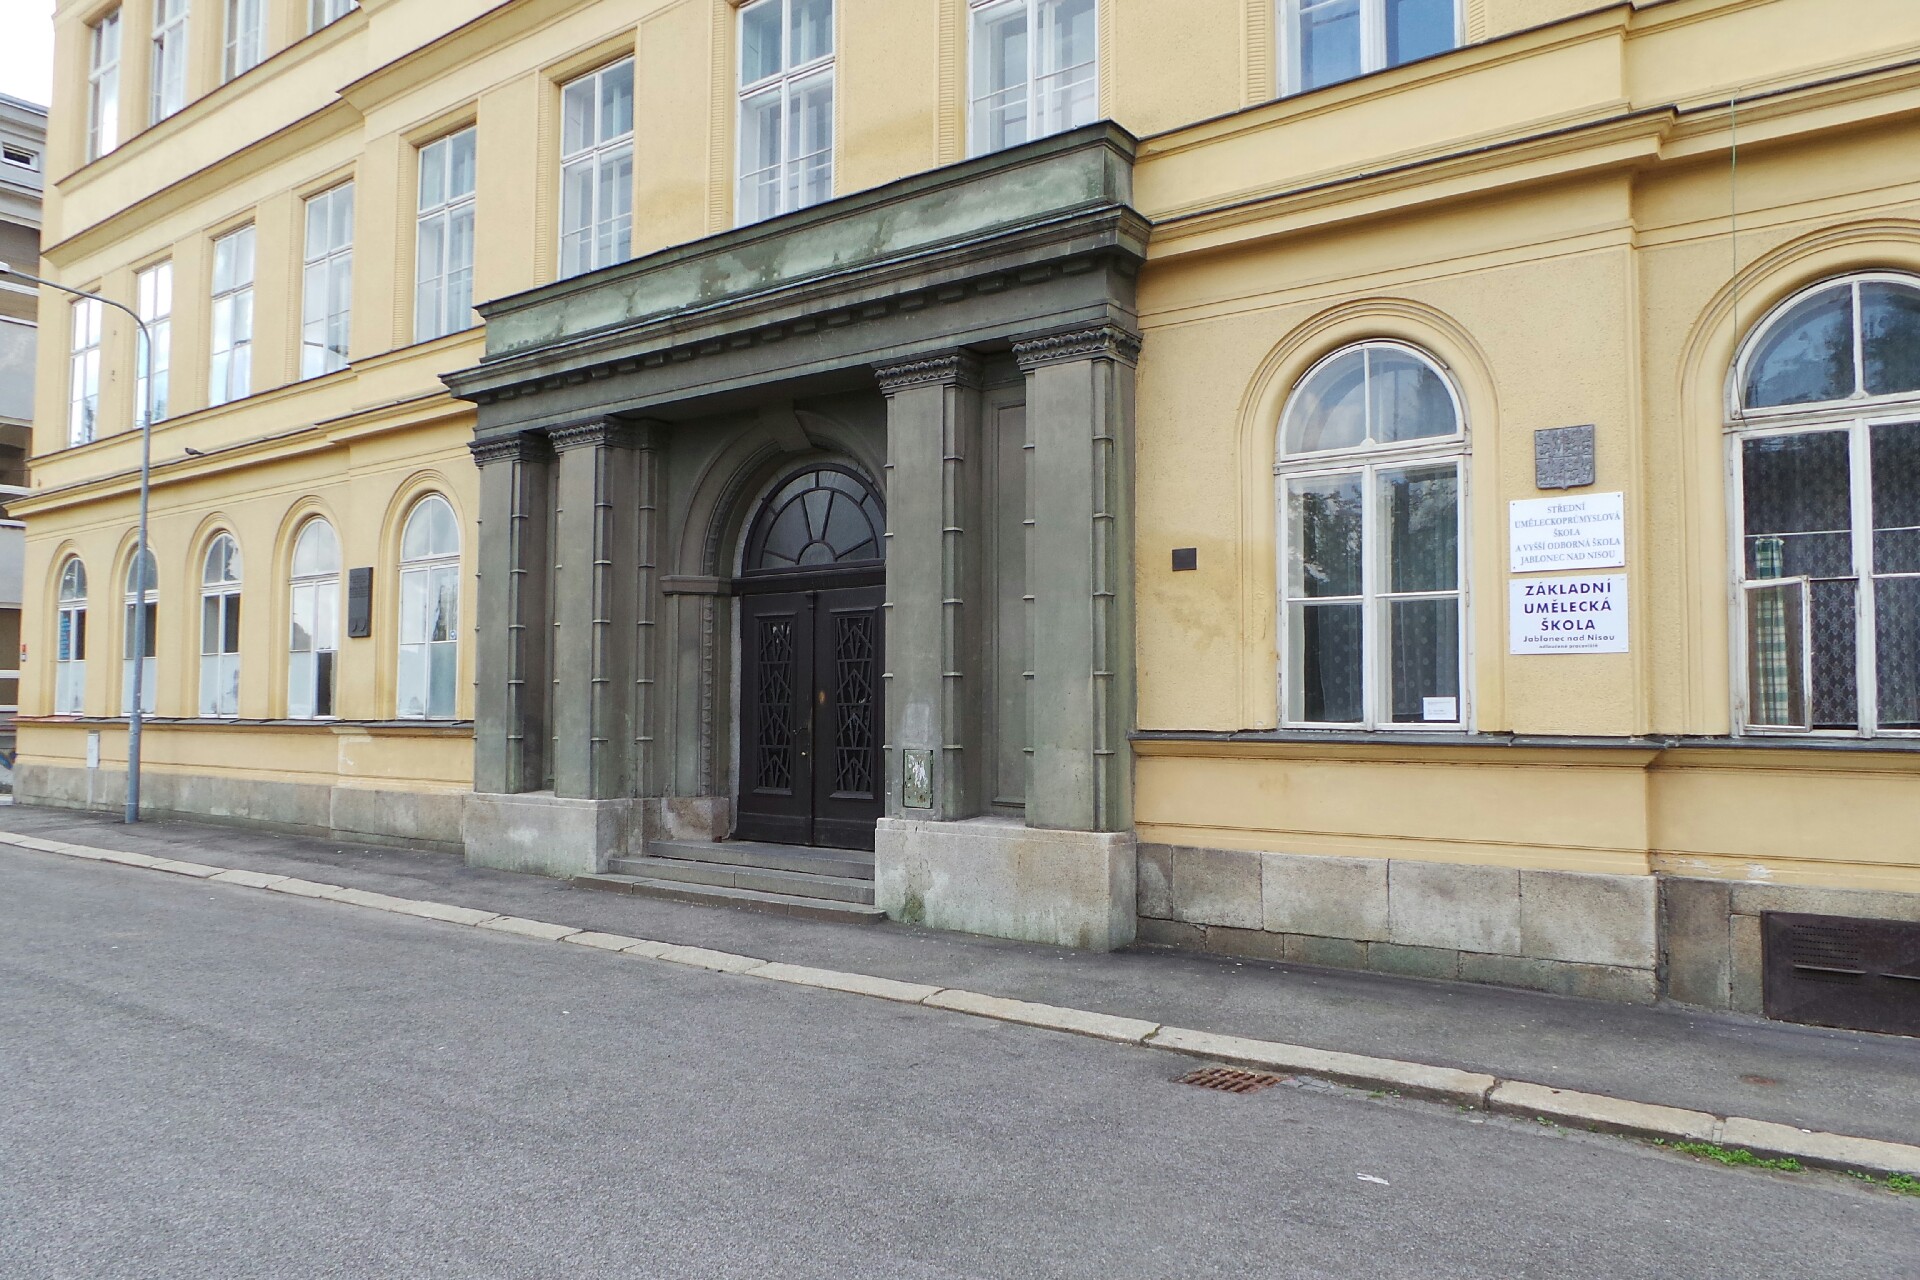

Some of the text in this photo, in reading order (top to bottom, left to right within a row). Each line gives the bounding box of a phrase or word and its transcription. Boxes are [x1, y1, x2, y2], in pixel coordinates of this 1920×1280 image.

[1547, 502, 1585, 514] STŘEDNÍ
[1514, 512, 1621, 528] UMĚLECKOPRŮMYSLOVÁ
[1553, 528, 1581, 537] ŠKOLA
[1523, 541, 1545, 551] VYŠŠÍ
[1547, 539, 1590, 550] ODBORNÁ
[1592, 537, 1621, 547] ŠKOLA
[1520, 550, 1616, 565] JABLONEC NAD NISOU
[1525, 578, 1611, 596] ZÁKLADNÍ
[1524, 596, 1612, 614] UMĚLECKÁ
[1541, 617, 1595, 631] ŠKOLA
[1523, 635, 1565, 643] Jablonec
